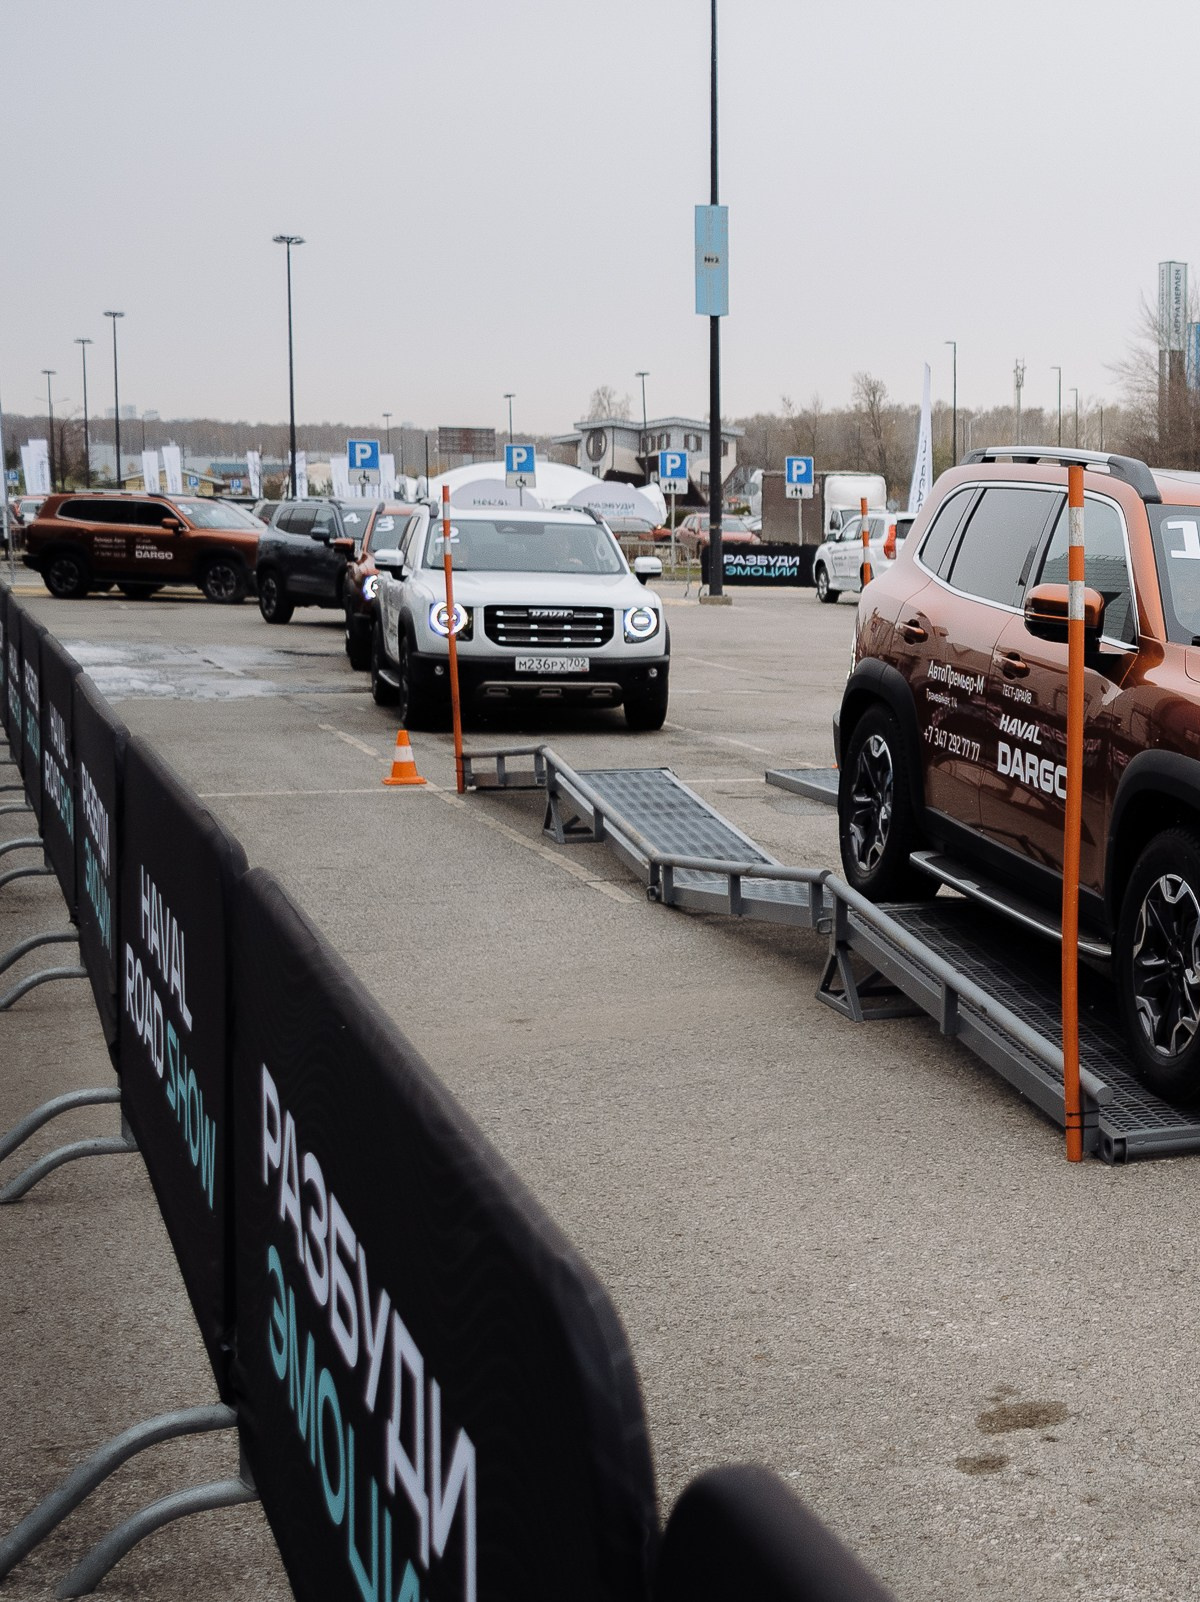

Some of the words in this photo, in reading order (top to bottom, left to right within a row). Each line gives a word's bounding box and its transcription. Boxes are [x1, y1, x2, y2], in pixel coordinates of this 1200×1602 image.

[355, 444, 371, 467] P
[513, 448, 527, 470] P
[666, 454, 681, 476] P
[793, 460, 806, 482] P
[723, 553, 800, 567] РАЗБУДИ
[725, 565, 798, 577] ЭМОЦИИ
[927, 659, 985, 696] АвтоПремьер-М
[1002, 683, 1033, 705] ТЕСТ-ДРАЙВ
[1000, 713, 1042, 745] HAVAL
[923, 725, 934, 743] +7
[933, 727, 948, 749] 347
[948, 732, 961, 755] 292
[960, 737, 971, 758] 77
[970, 741, 981, 762] 77
[140, 864, 193, 1033] HAVAL
[125, 942, 165, 1080] ROAD
[166, 1019, 217, 1211] SHOW
[262, 1062, 477, 1602] РАЗБУДИ
[267, 1244, 430, 1602] ЭМОЦ
